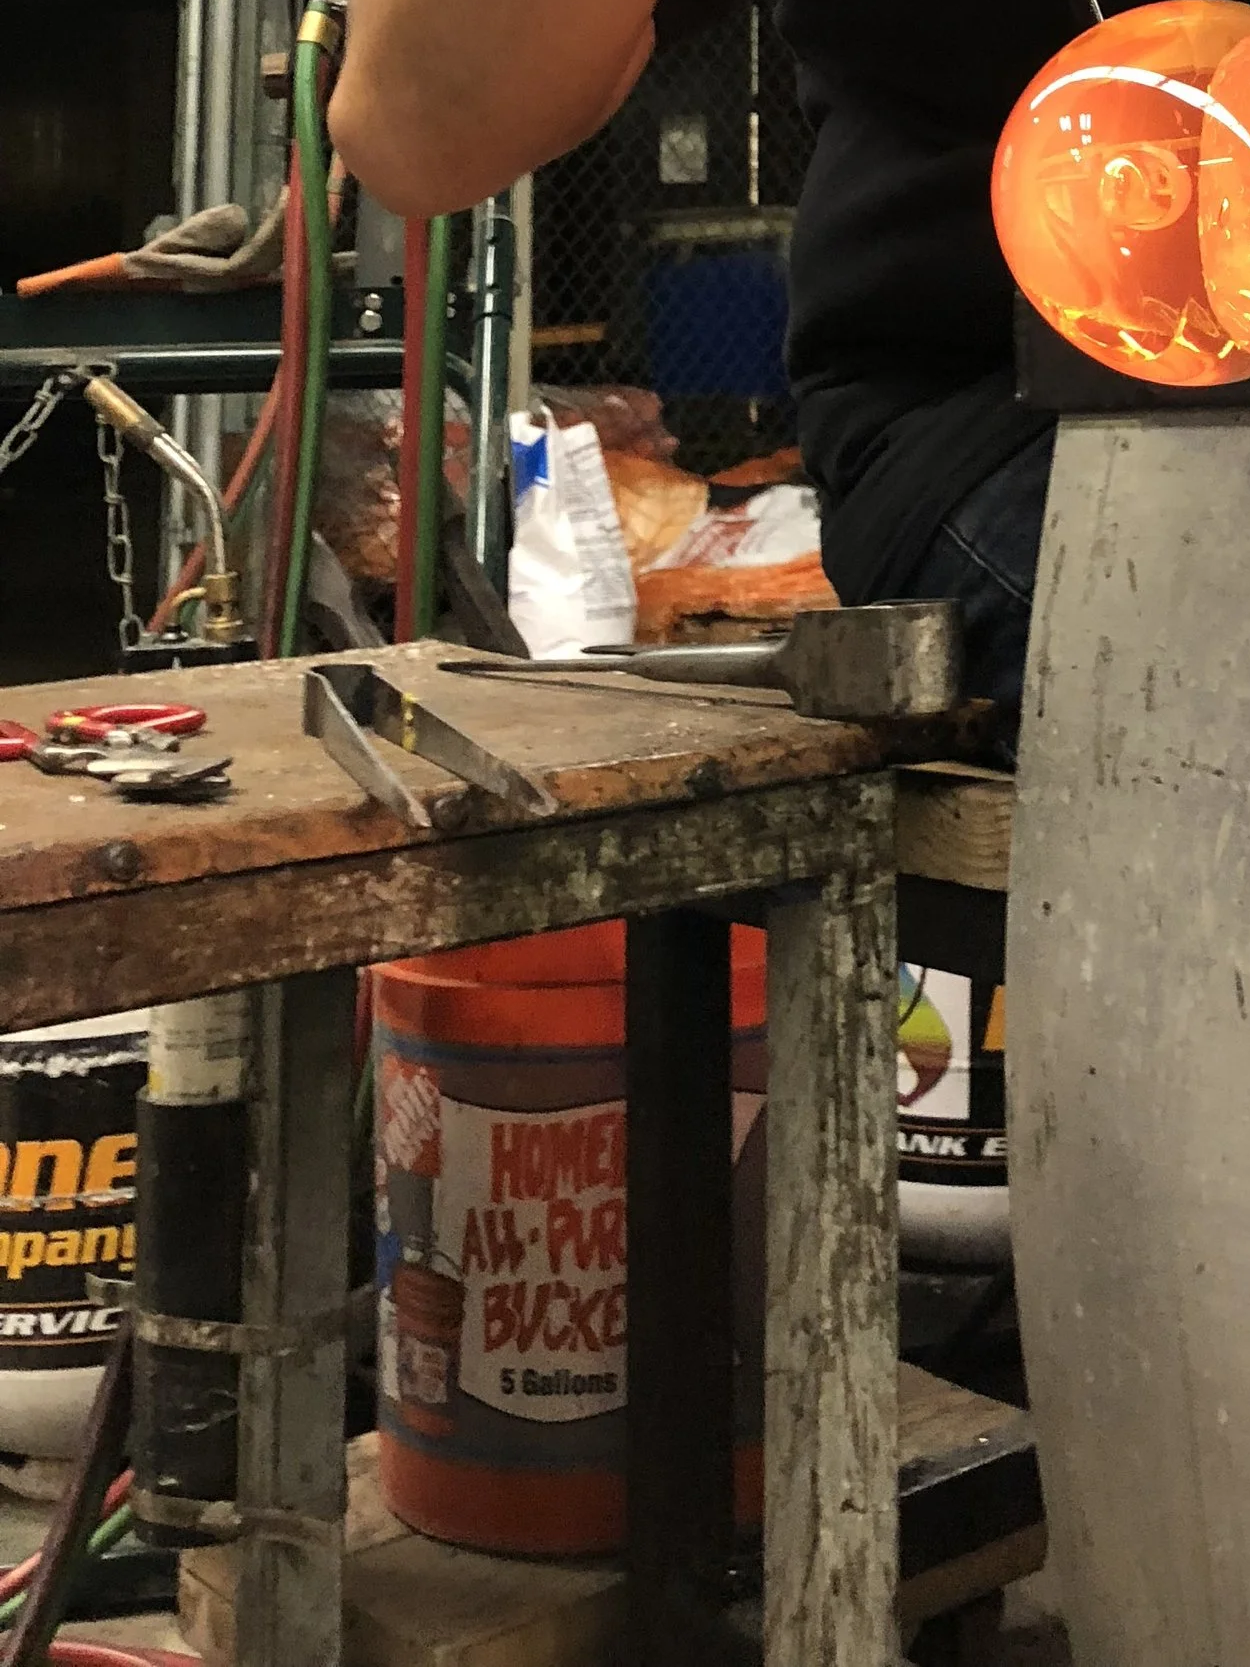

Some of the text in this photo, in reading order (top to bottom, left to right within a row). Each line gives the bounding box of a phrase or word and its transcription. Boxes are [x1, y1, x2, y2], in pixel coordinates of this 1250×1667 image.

[0, 1133, 138, 1211] ne
[0, 1222, 137, 1280] pan
[0, 1307, 124, 1336] RVIC
[483, 1279, 627, 1353] BUCKE
[501, 1367, 620, 1396] 5 Gallons
